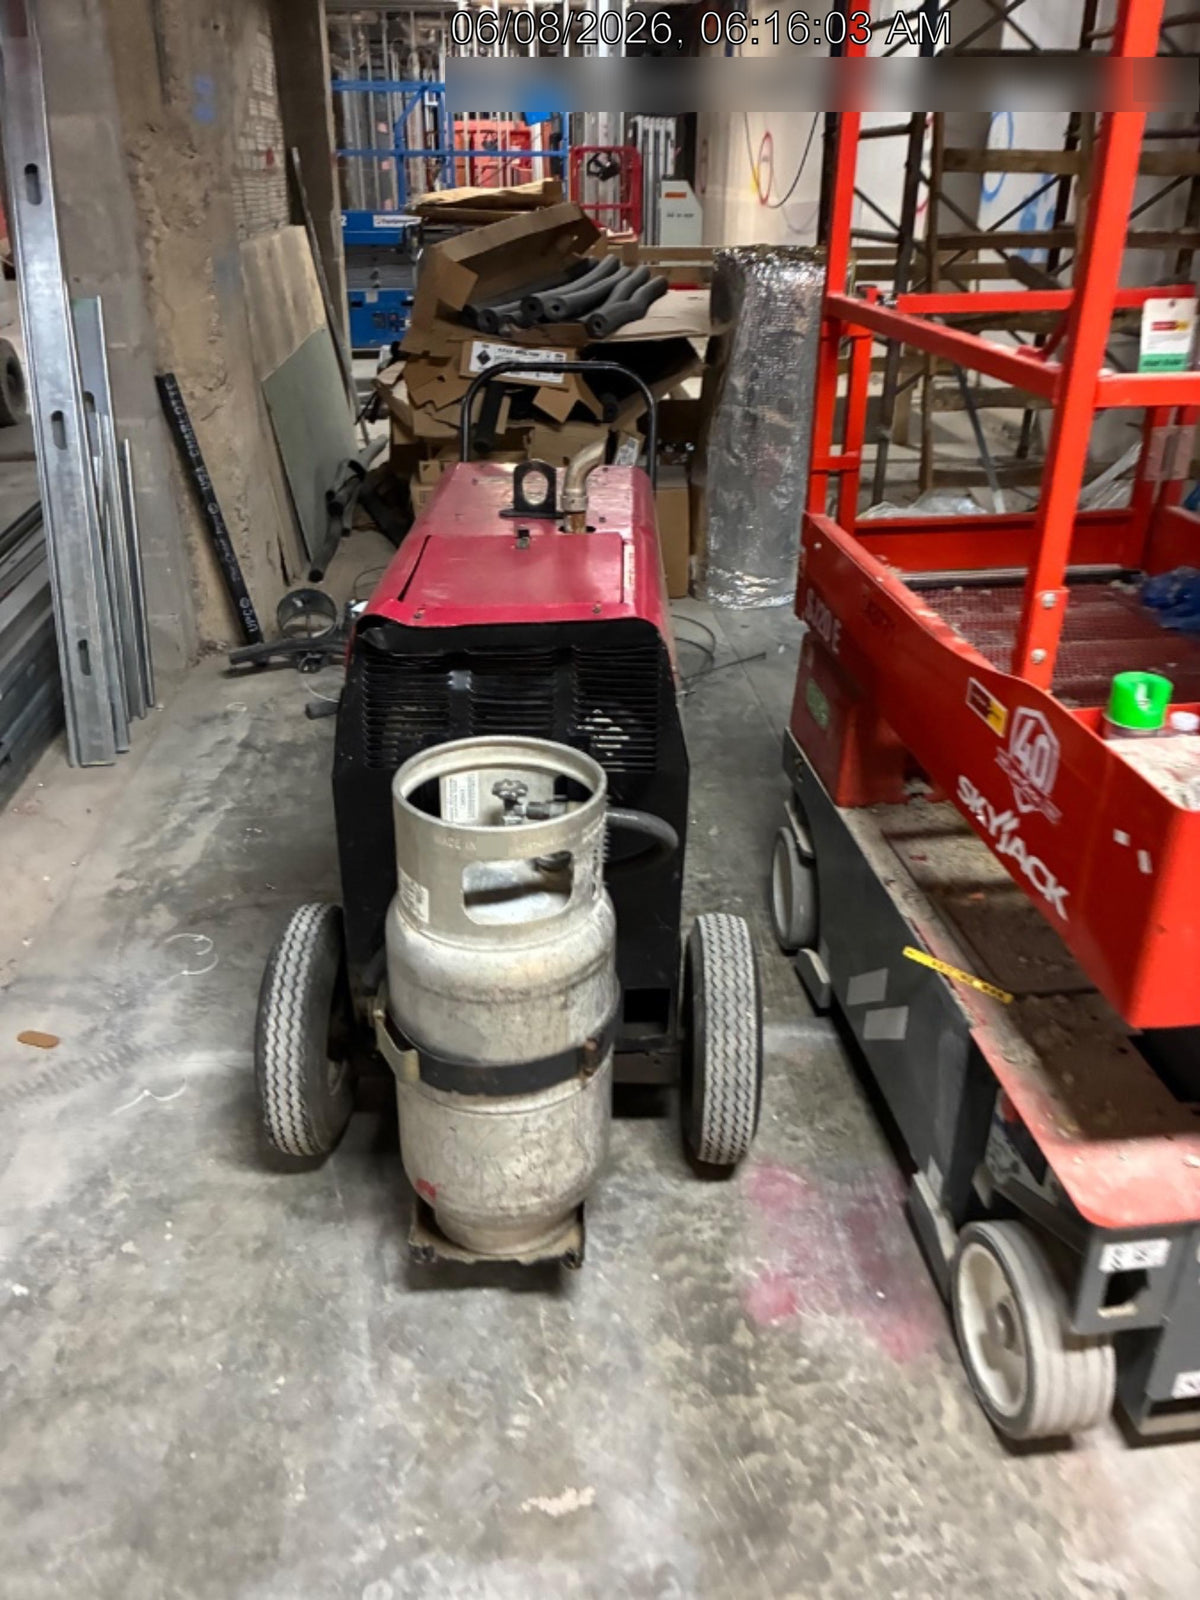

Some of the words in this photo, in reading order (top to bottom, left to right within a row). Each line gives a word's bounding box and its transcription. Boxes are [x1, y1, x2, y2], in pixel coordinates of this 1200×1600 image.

[164, 382, 201, 458] CHARLOTTE
[1012, 717, 1050, 788] 40
[957, 774, 1070, 922] SKYJACK
